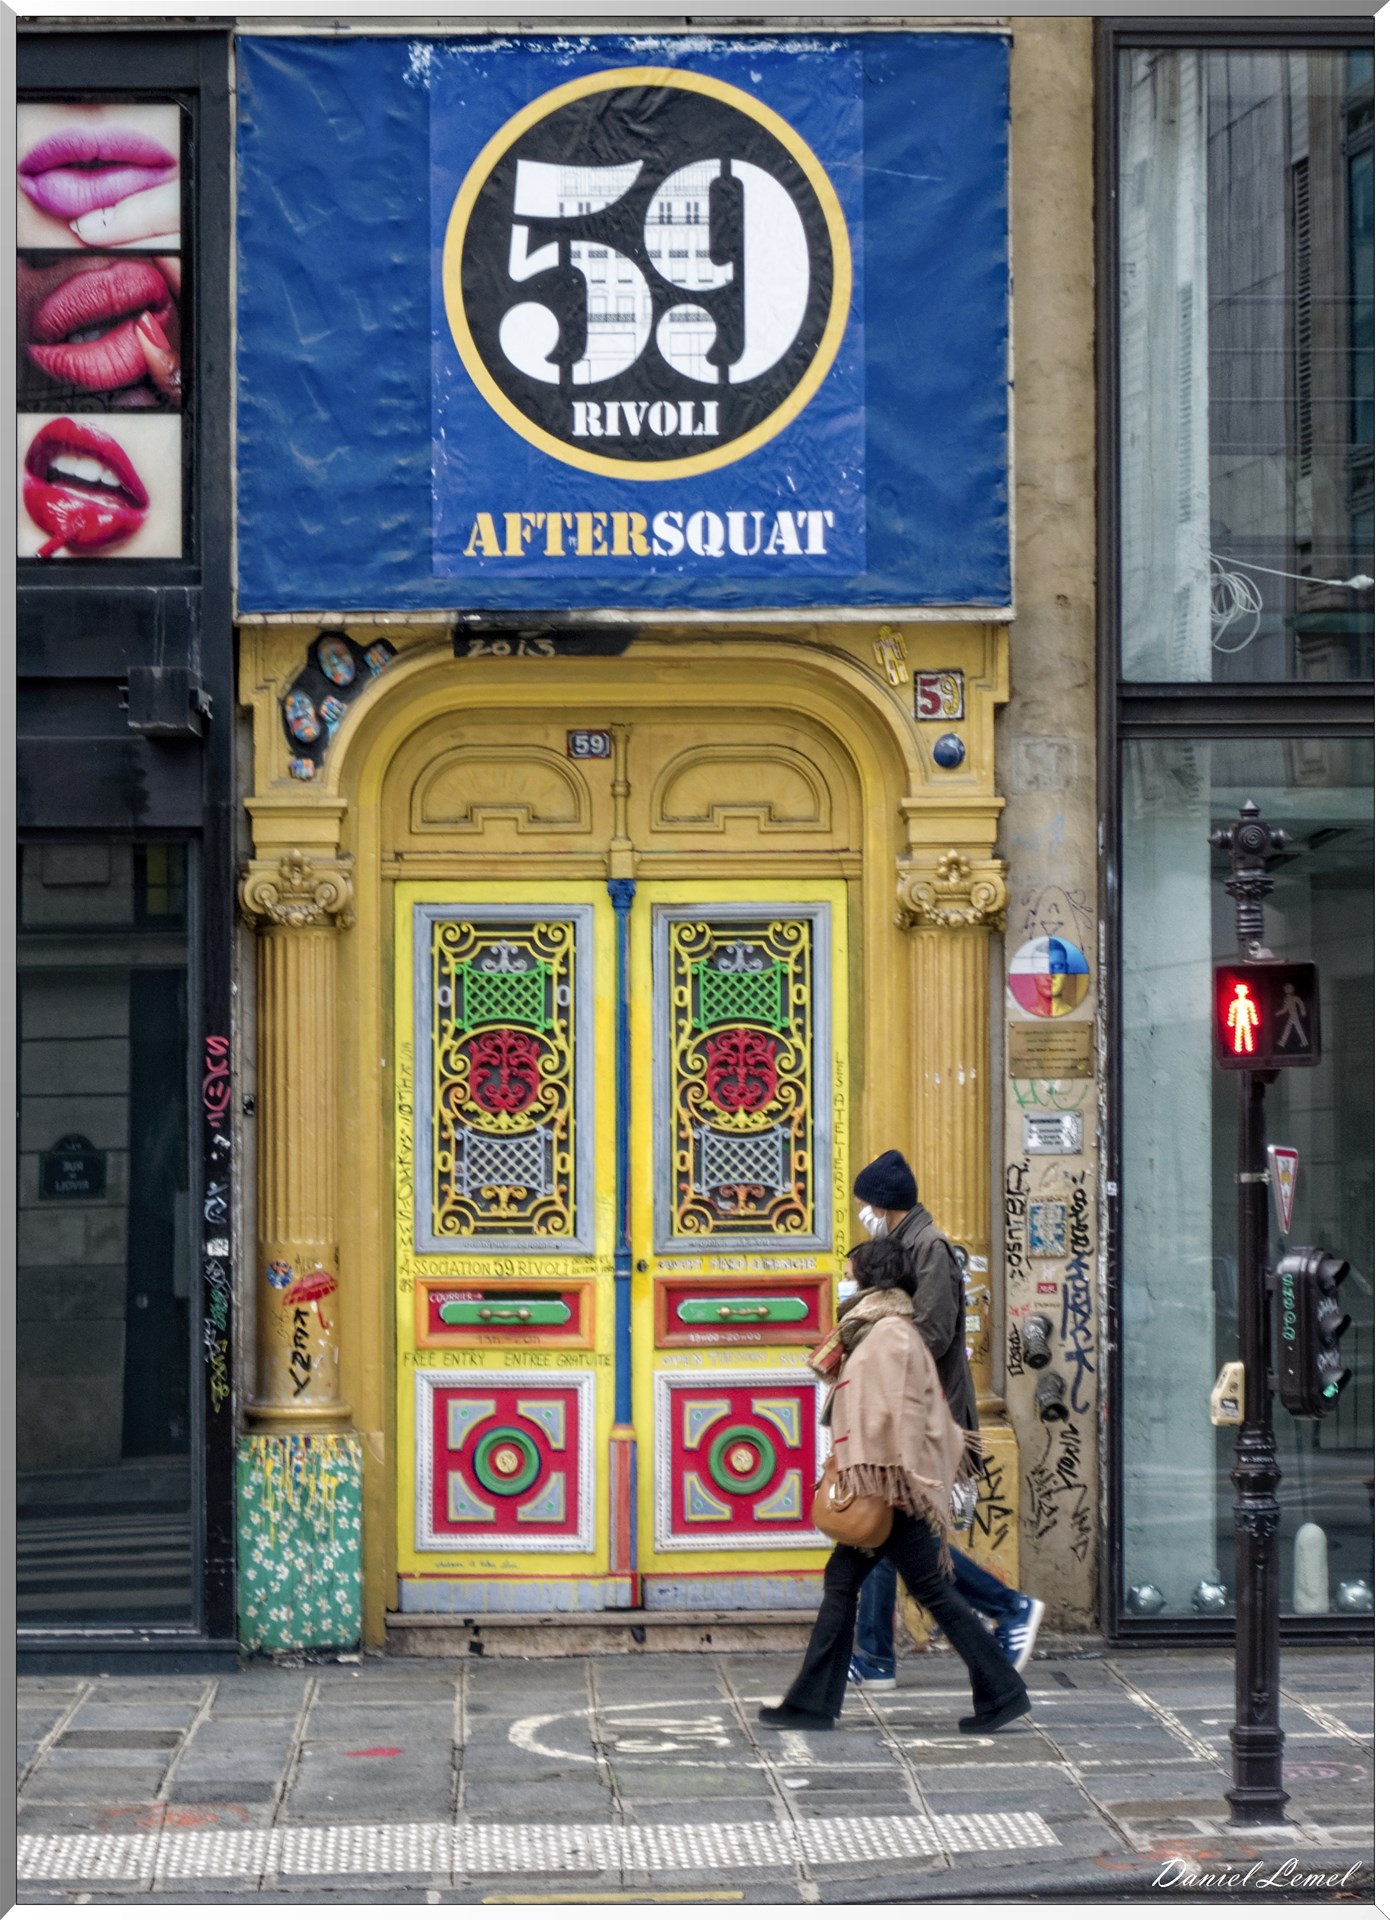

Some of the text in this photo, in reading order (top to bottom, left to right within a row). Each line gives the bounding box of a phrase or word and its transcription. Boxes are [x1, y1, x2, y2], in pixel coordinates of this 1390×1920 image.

[499, 158, 810, 385] 59
[571, 401, 720, 437] RIVOLI
[463, 510, 835, 558] AFTERSQUAT
[918, 673, 962, 716] 59
[574, 735, 606, 754] 59
[493, 1259, 515, 1277] 59
[518, 1259, 570, 1276] RIVOLI
[404, 1353, 436, 1367] FREE
[443, 1353, 487, 1367] ENTRY
[556, 1353, 613, 1367] GRATUITE
[662, 1351, 703, 1367] OPEN
